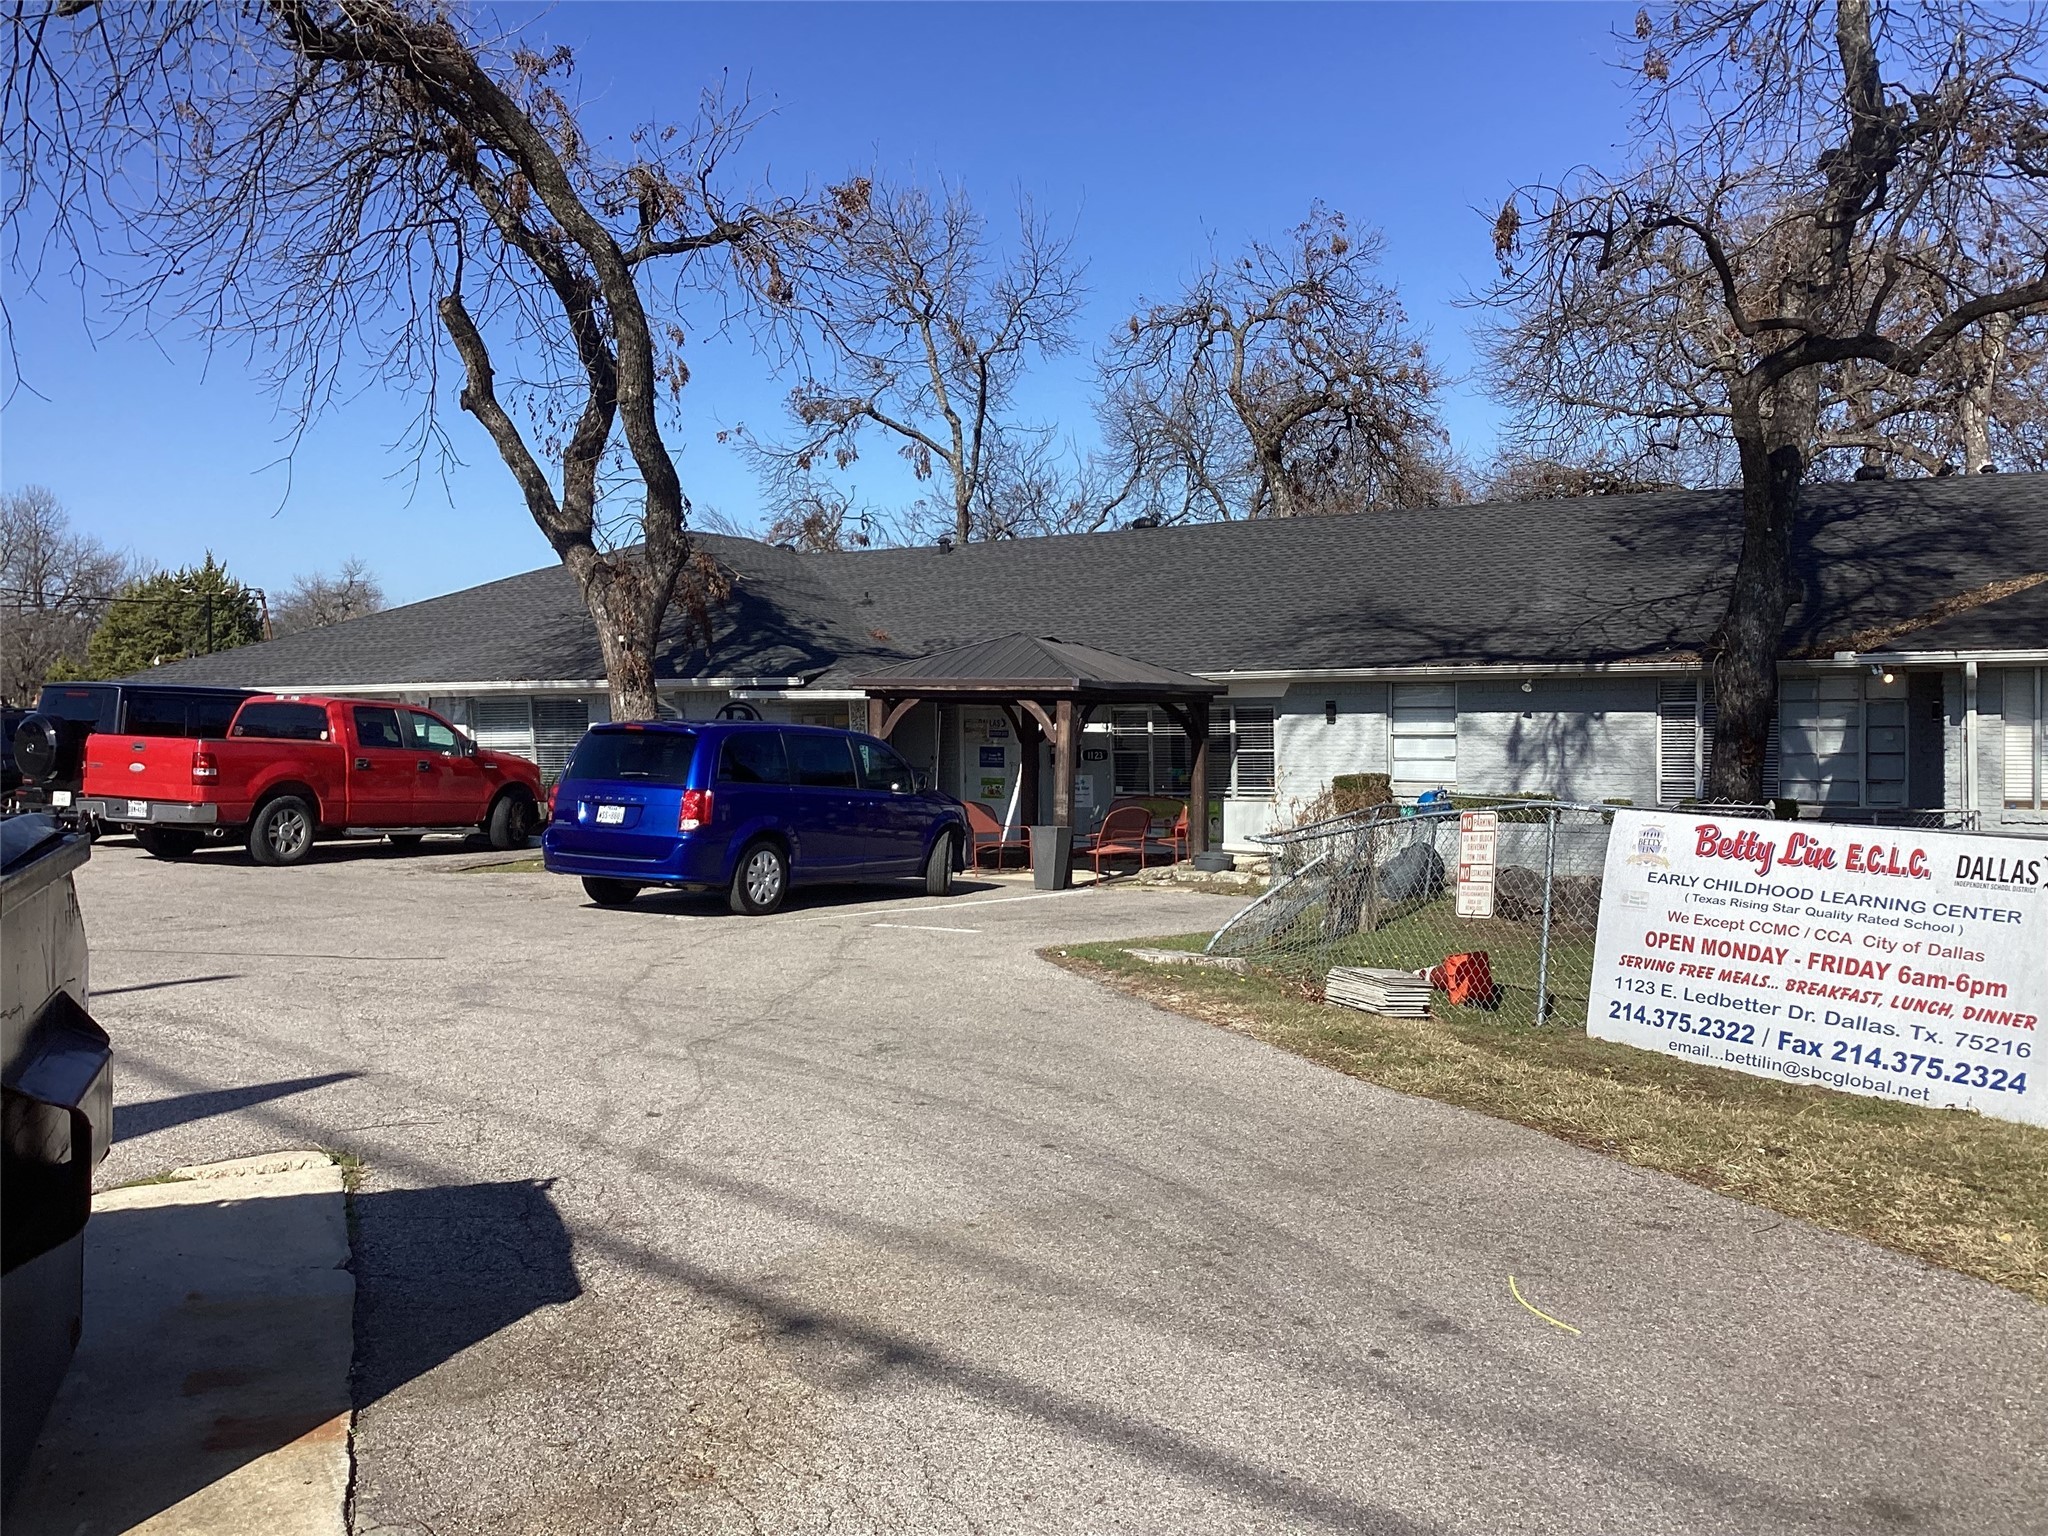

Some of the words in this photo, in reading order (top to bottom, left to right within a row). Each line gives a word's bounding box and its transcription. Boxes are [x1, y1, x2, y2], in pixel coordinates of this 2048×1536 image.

[1087, 751, 1103, 760] 1123
[1462, 817, 1472, 830] NO
[1474, 818, 1494, 828] PARKING
[1639, 838, 1663, 847] BETTY
[1460, 866, 1470, 880] NO
[1641, 846, 1655, 854] LIN
[1695, 824, 1776, 877] Betty
[1777, 832, 1837, 870] Lin
[1845, 843, 1932, 880] E.C.L.C.
[1956, 855, 2040, 885] DALLAS
[1647, 872, 1700, 887] EARLY
[1703, 878, 1814, 900] CHILDHOOD
[1820, 891, 1926, 913] LEARNING
[1933, 903, 2022, 924] CENTER
[1954, 881, 1989, 890] INDEPENDENT
[1990, 884, 2011, 892] SCHOOL
[2012, 886, 2037, 894] DISTRICT
[1667, 910, 1689, 924] We
[1693, 914, 1745, 932] Except
[1749, 921, 1800, 937] CCMC
[1814, 929, 1852, 945] CCA
[1863, 935, 1898, 953] City
[1903, 942, 1922, 954] of
[1928, 943, 1985, 962] Dallas
[1692, 893, 1726, 906] Texas
[1730, 897, 1769, 913] Rising
[1772, 903, 1800, 914] Star
[1805, 907, 1853, 923] Quality
[1857, 913, 1899, 927] Rated
[1903, 919, 1955, 933] School
[1645, 931, 1695, 953] OPEN
[1701, 938, 1789, 965] MONDAY
[1807, 952, 1892, 980] FRIDAY
[1898, 965, 2008, 998] 6am-6pm
[1618, 954, 1675, 973] SERVING
[1679, 963, 1715, 980] FREE
[1718, 969, 1778, 990] MEALS...
[1785, 979, 1883, 1008] BREAKFAST,
[1890, 995, 1954, 1019] LUNCH,
[1962, 1006, 2038, 1031] DINNER
[1614, 976, 1655, 995] 1123
[1661, 984, 1677, 999] E.
[1684, 987, 1781, 1016] Ledbetter
[1788, 1005, 1815, 1022] Dr.
[1824, 1010, 1900, 1037] Dallas.
[1910, 1024, 1943, 1044] Tx.
[1955, 1032, 2031, 1058] 75216
[1609, 1000, 1755, 1045] 214.375.2322
[1777, 1030, 1824, 1058] Fax
[1831, 1040, 2027, 1094] 214.375.2324
[1669, 1041, 1930, 1101] email...bettilin@sbcglobal.net
